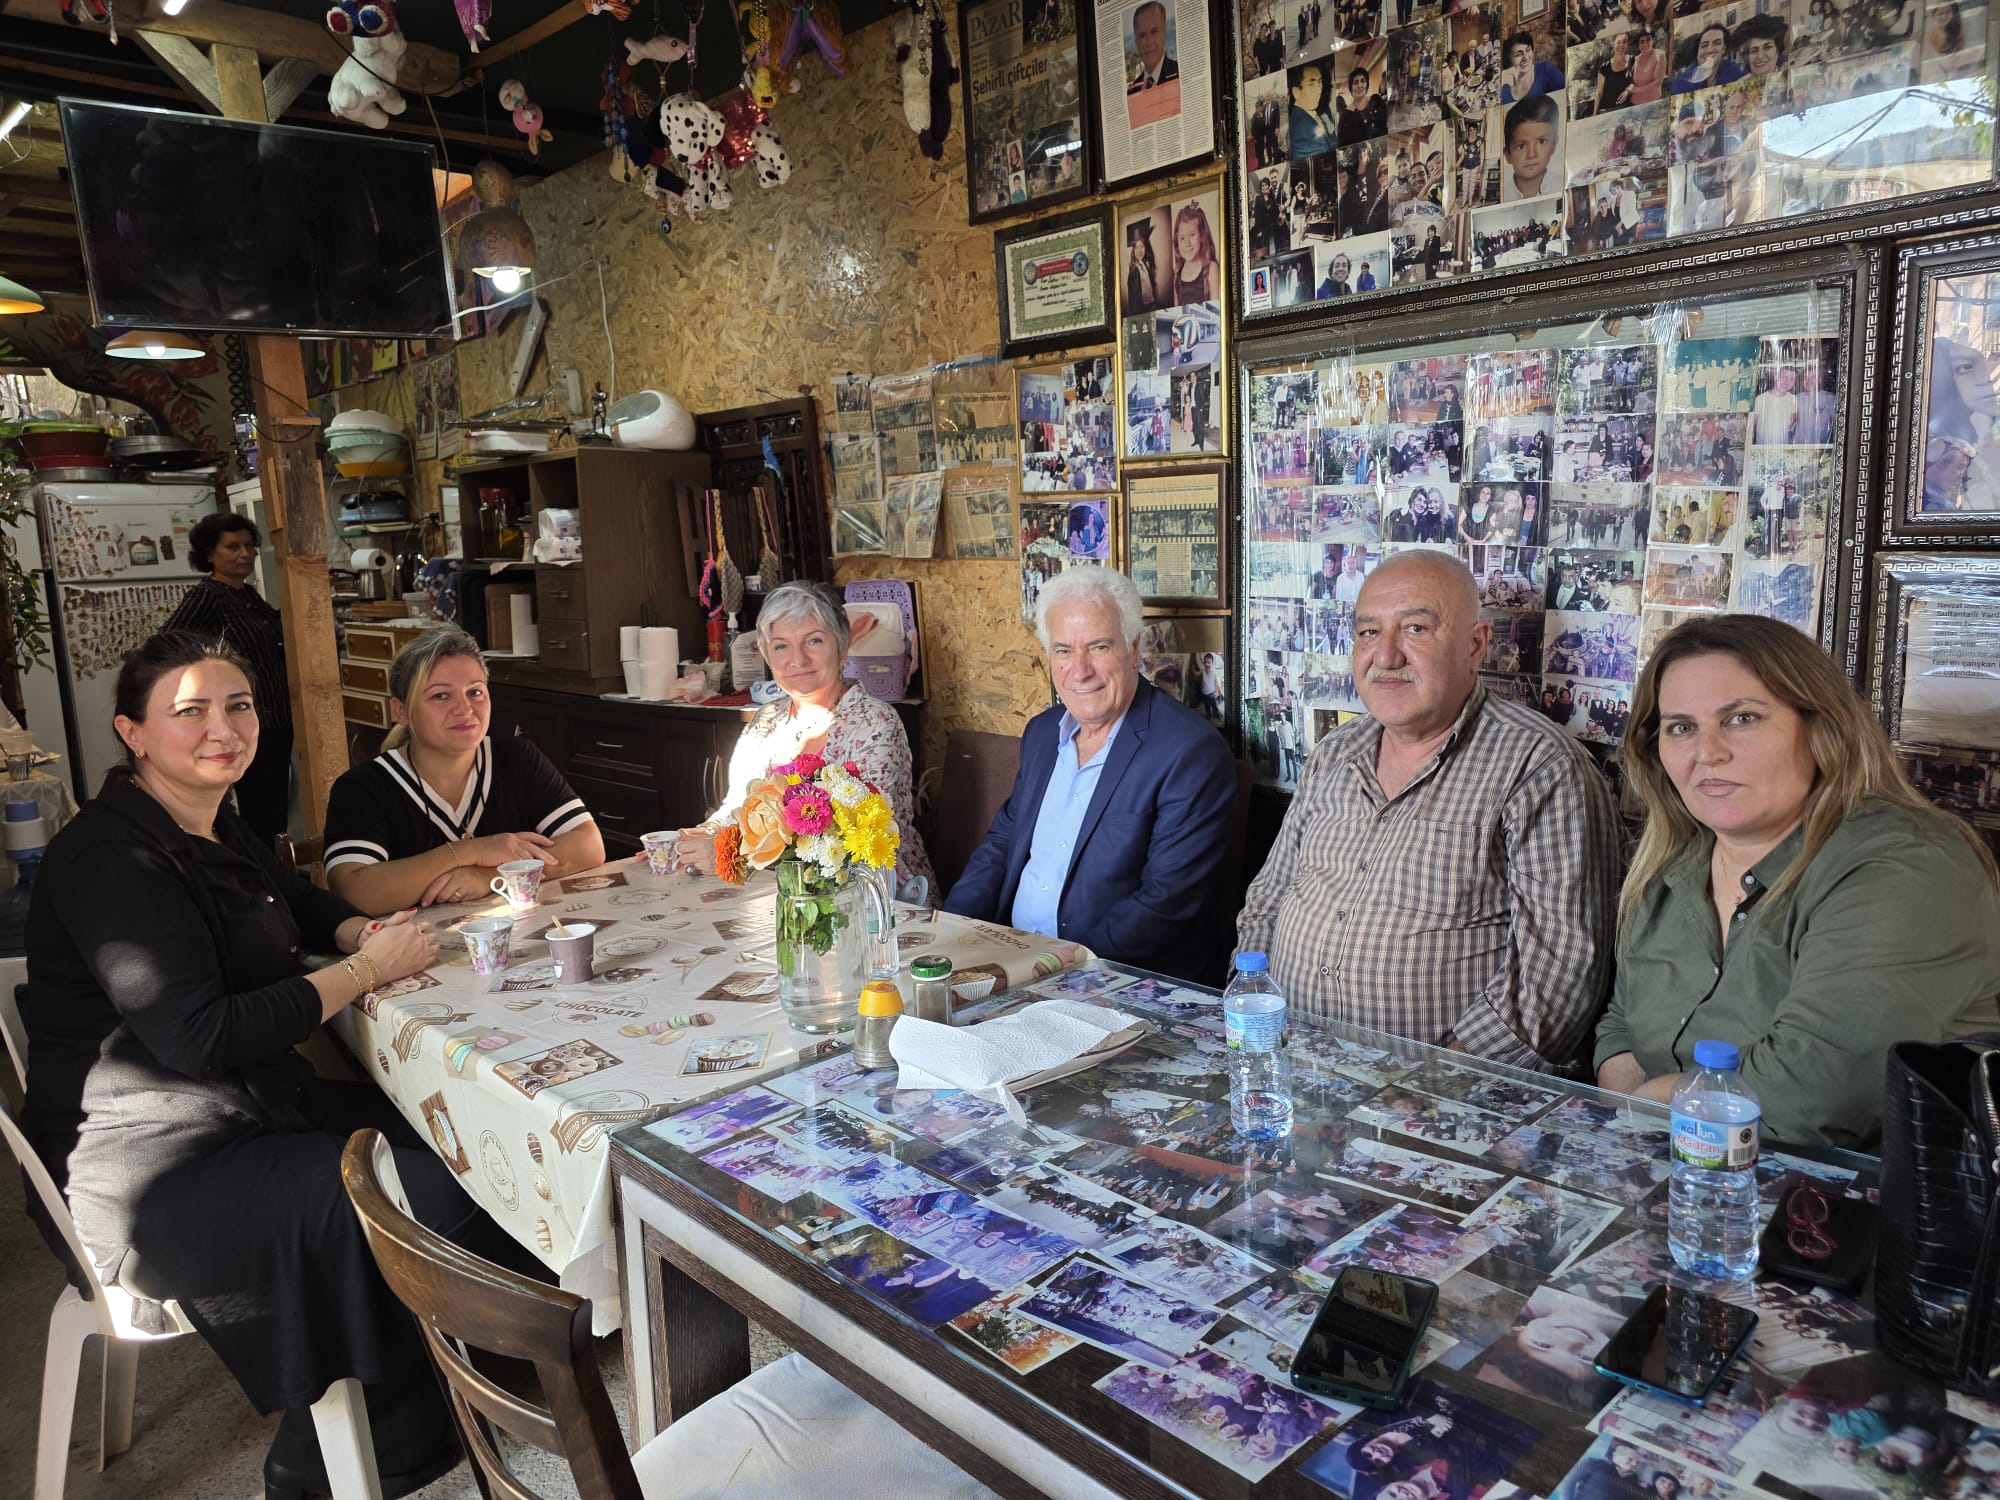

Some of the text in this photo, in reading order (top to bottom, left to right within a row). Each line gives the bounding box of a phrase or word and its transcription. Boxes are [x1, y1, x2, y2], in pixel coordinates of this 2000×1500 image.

[969, 0, 1021, 41] PAZAR
[972, 69, 1005, 99] Şehirli
[1007, 57, 1047, 89] çiftçiler
[554, 1002, 645, 1018] CHOCOLATE
[1680, 1121, 1715, 1139] kaltun
[1677, 1134, 1720, 1154] Madran
